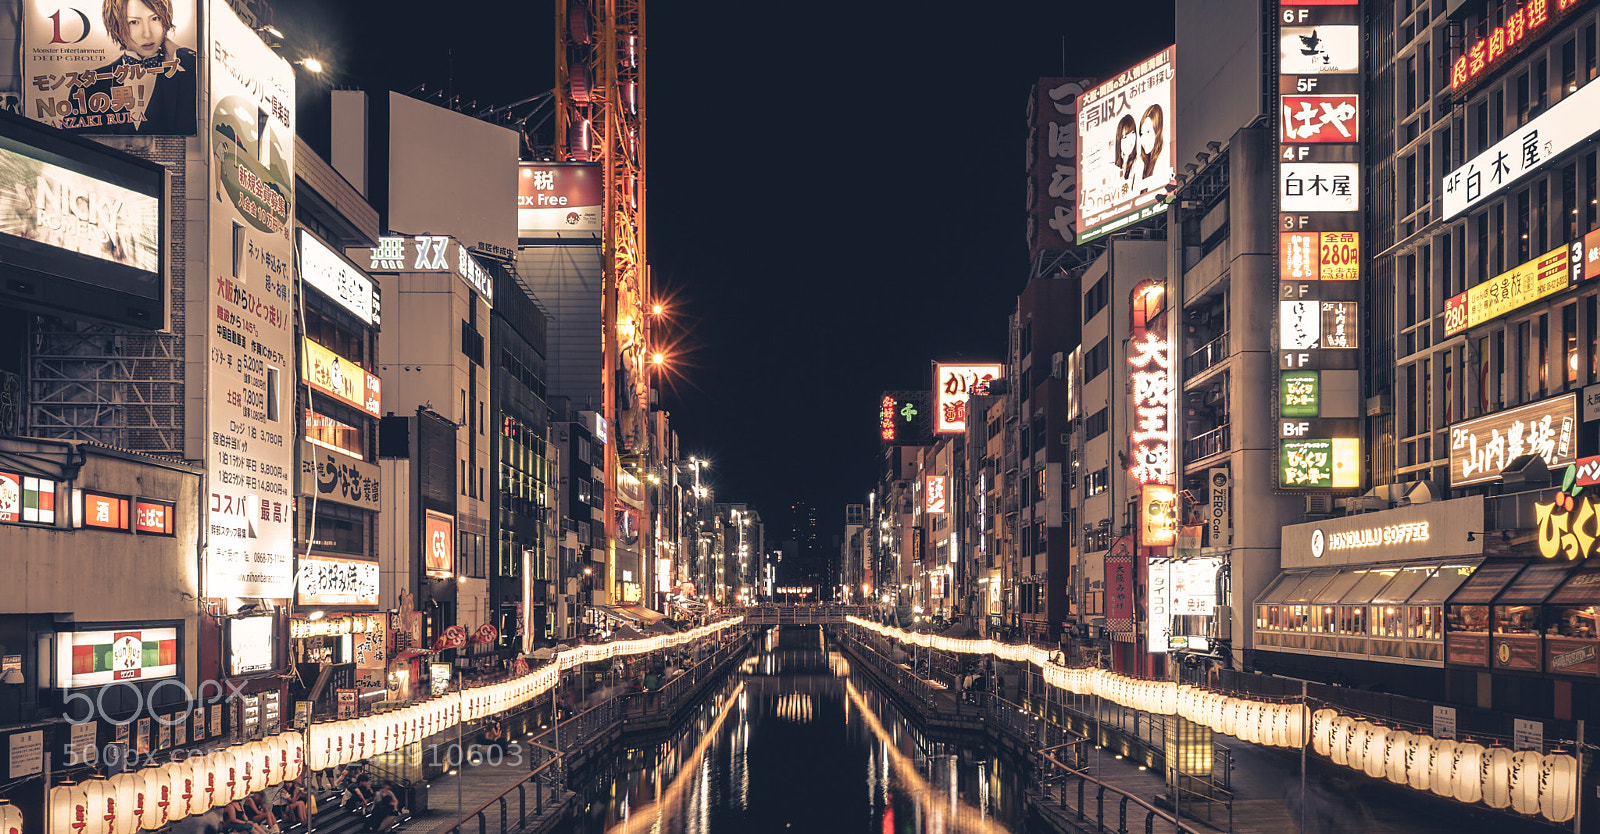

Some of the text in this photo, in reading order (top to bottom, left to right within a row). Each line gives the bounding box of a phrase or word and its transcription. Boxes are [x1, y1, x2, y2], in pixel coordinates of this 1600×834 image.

[1283, 9, 1309, 23] 6F
[33, 58, 180, 91] モンスターグループ
[1297, 79, 1317, 92] 5F
[107, 112, 148, 126] RUKA
[1085, 91, 1131, 132] 高収入
[1282, 147, 1309, 160] 4F
[1447, 129, 1540, 203] 4F 白木屋
[239, 164, 285, 218] 新規会員募集
[533, 170, 554, 191] 税
[1285, 172, 1352, 197] 白木屋
[537, 194, 568, 206] Free
[37, 176, 123, 248] NICKY
[1284, 216, 1309, 230] 3F
[1325, 233, 1354, 243] 全品
[1321, 244, 1358, 265] 280円
[1572, 241, 1582, 280] 3F
[1284, 284, 1309, 298] 2F
[1490, 272, 1522, 307] 鳥貴族
[1446, 294, 1466, 310] 全品
[1284, 353, 1309, 368] 1F
[1128, 332, 1168, 484] 大阪王将
[1283, 422, 1309, 436] B1F
[1452, 428, 1468, 449] 2F
[1462, 414, 1556, 478] 山内農場
[1287, 449, 1328, 468] びっくり
[1285, 467, 1330, 484] ドンキー
[96, 500, 110, 523] 酒
[212, 493, 246, 517] コスパ
[1213, 489, 1223, 539] ZERO cafe
[137, 507, 164, 528] たばこ
[1535, 496, 1600, 561] びっく
[432, 531, 446, 560] G3
[1329, 521, 1429, 550] HONOLULU COFFEE
